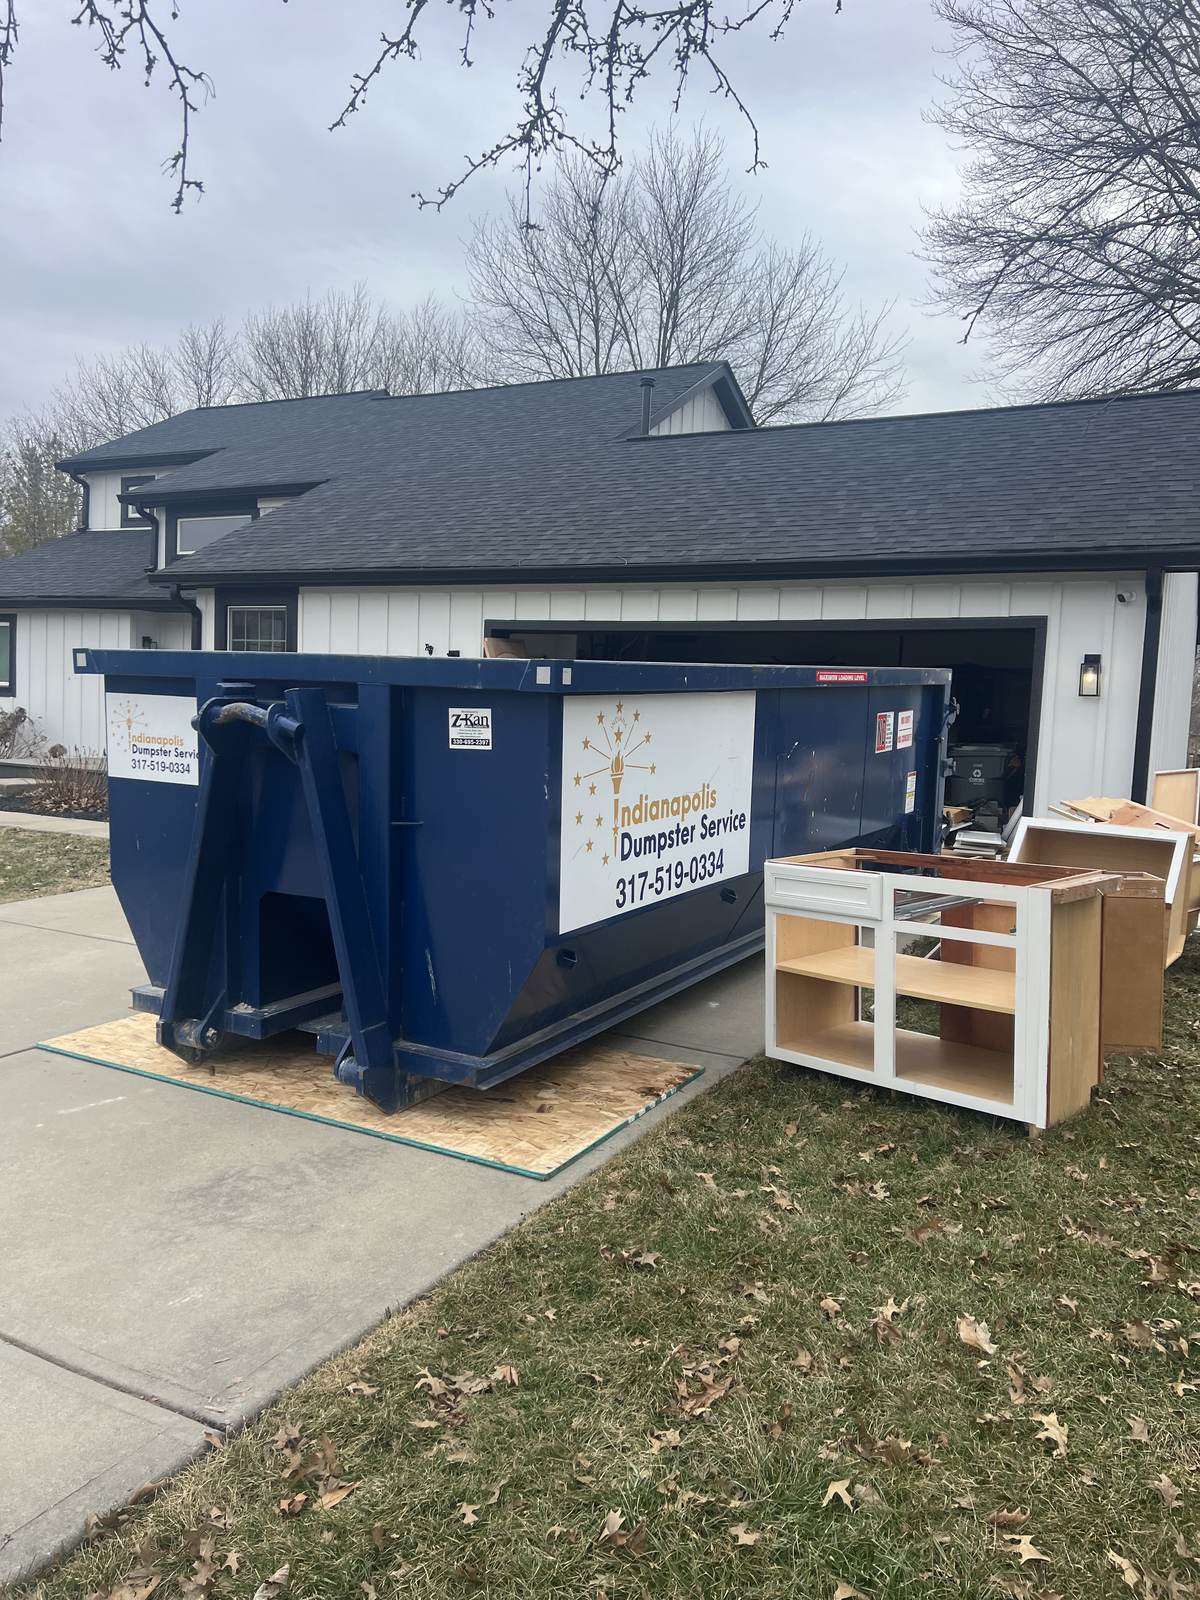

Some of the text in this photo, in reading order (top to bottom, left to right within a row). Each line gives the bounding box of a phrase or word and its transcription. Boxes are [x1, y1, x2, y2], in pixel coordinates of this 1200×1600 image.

[451, 713, 489, 728] Z-Kan
[128, 732, 184, 747] Indianapolis
[132, 744, 199, 760] Dumpster Servic
[131, 758, 191, 774] 317-519-0334
[613, 783, 717, 829] Indianapolis
[620, 809, 746, 862] Dumpster Service
[615, 848, 724, 908] 317-519-0334
